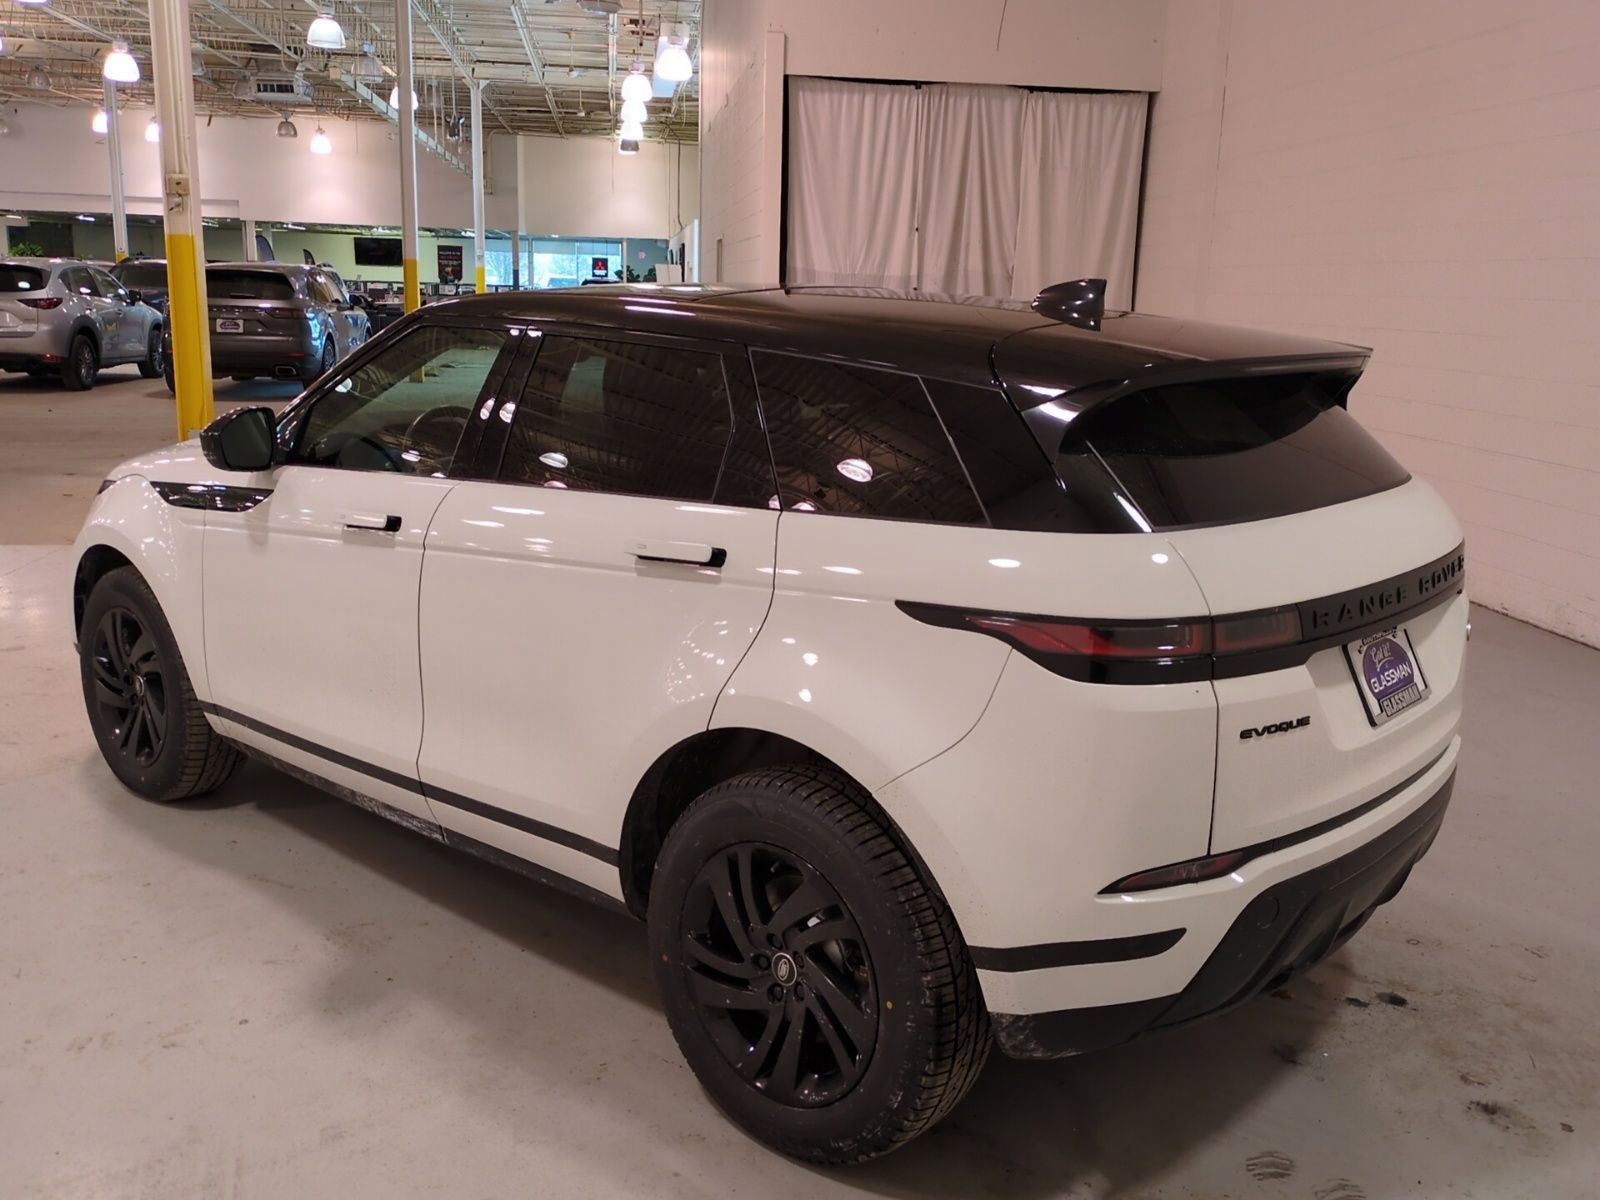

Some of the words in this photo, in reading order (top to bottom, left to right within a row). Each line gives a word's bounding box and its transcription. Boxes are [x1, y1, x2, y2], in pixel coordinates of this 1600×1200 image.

[1312, 586, 1407, 629] RANGE
[1370, 661, 1412, 692] GLASSMAN
[1382, 684, 1421, 716] GLASSMAN
[1240, 715, 1311, 740] EVOQUE
